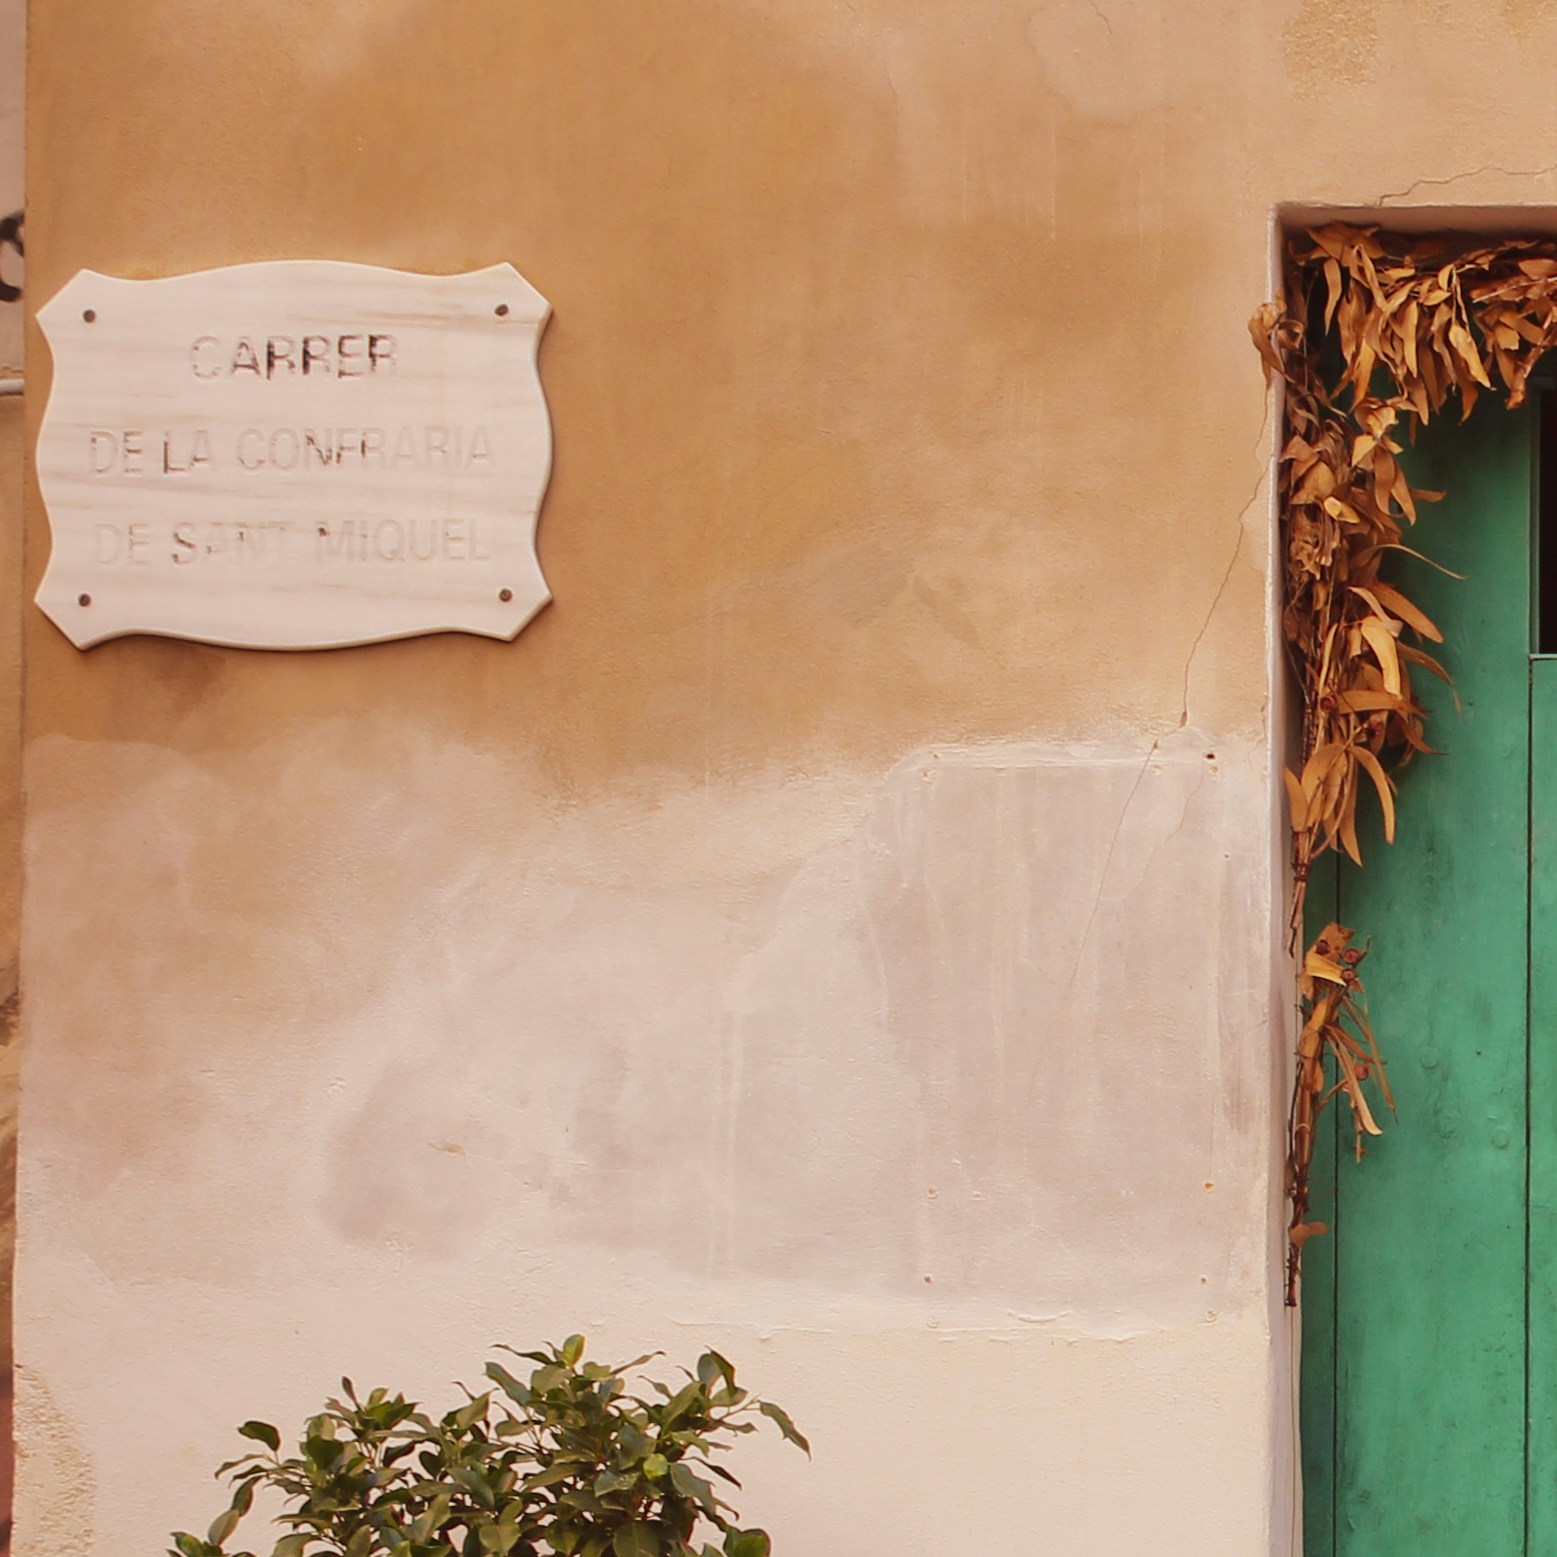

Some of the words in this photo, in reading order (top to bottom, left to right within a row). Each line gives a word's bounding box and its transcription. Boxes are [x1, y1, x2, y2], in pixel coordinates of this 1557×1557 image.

[188, 333, 399, 381] CARRER
[89, 428, 145, 475] DE
[162, 428, 217, 474] LA
[236, 425, 494, 471] CONFRARIA
[95, 522, 151, 566] DE
[314, 518, 492, 565] MIQUEL
